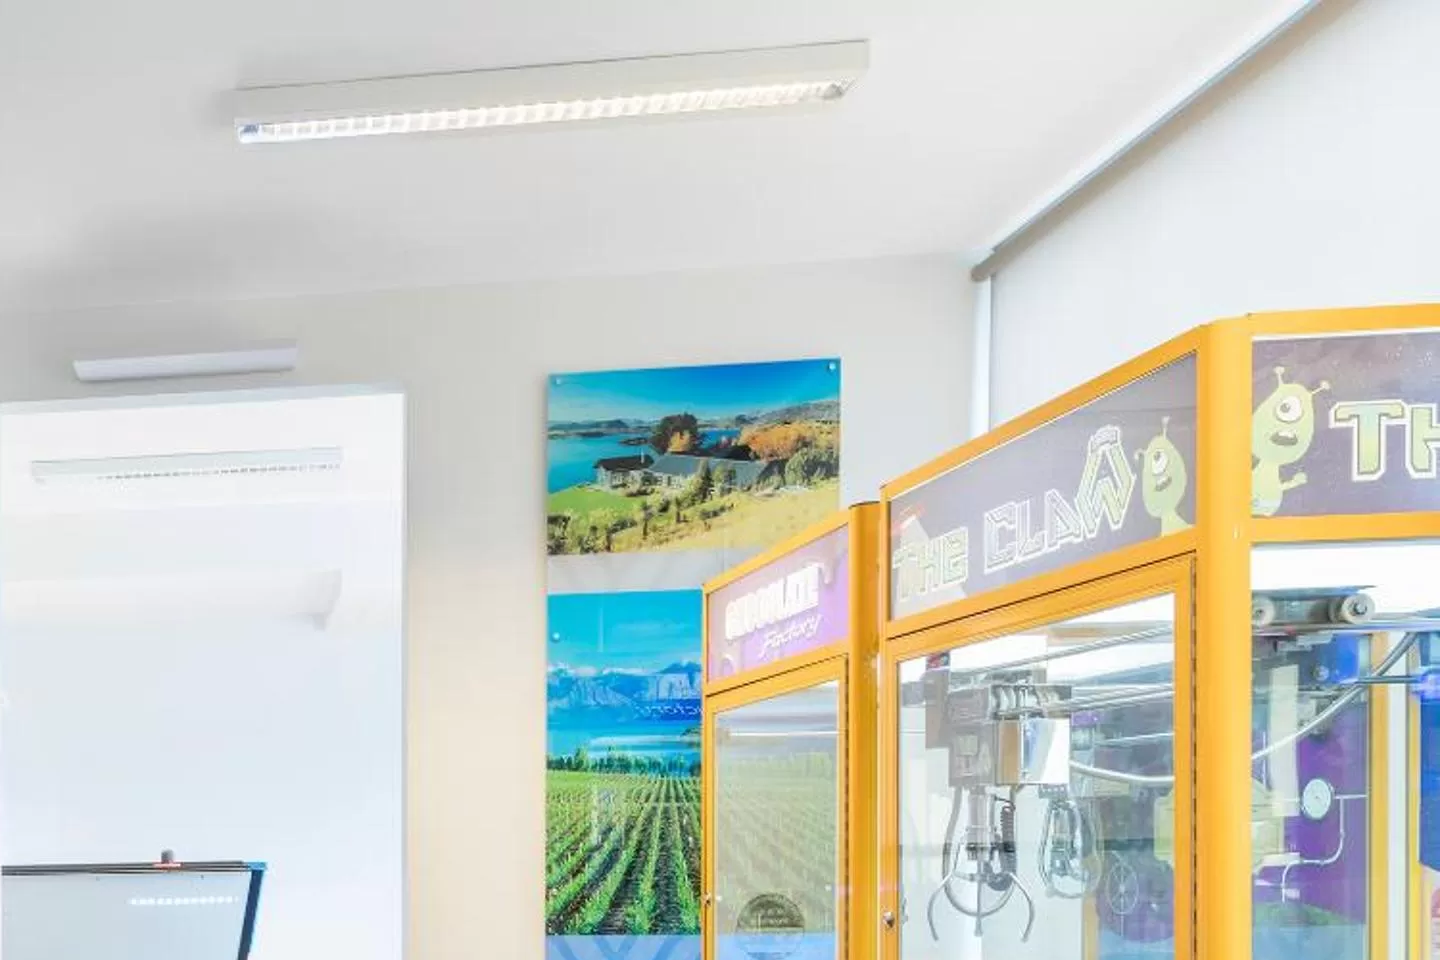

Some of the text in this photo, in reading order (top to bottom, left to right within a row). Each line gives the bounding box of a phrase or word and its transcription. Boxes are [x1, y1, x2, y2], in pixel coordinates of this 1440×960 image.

[892, 424, 1137, 601] THE CLAW
[758, 614, 824, 659] Factory
